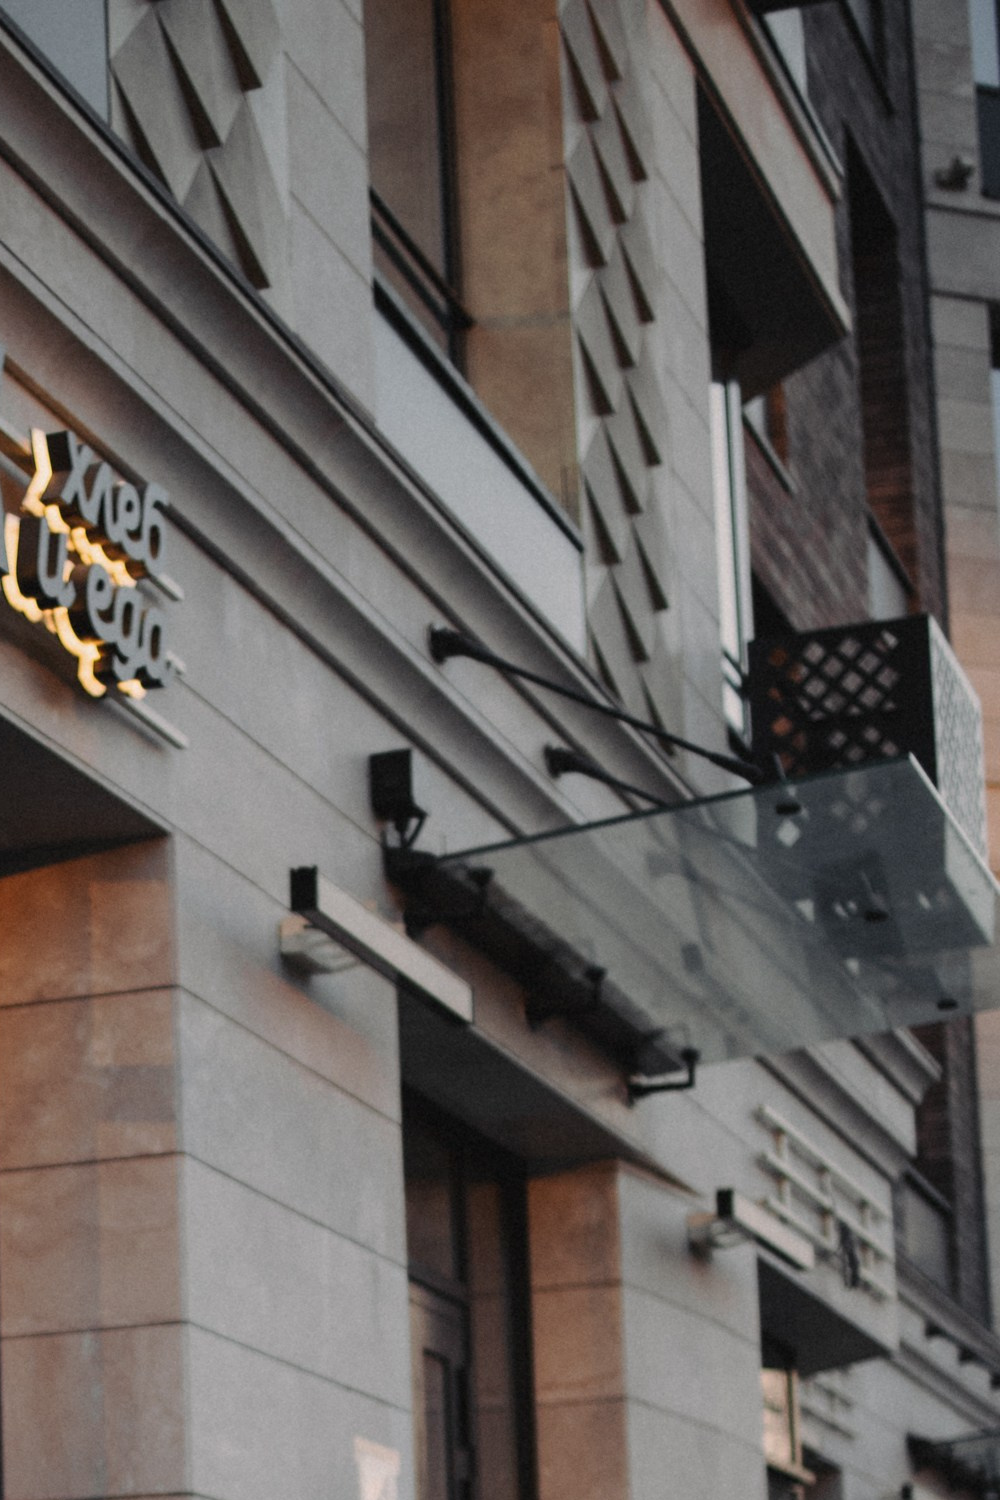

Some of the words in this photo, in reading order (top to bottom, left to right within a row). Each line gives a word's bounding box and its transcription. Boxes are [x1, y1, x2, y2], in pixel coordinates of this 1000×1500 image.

[58, 429, 169, 576] хлеб
[29, 515, 77, 609] и
[85, 562, 175, 686] еда
